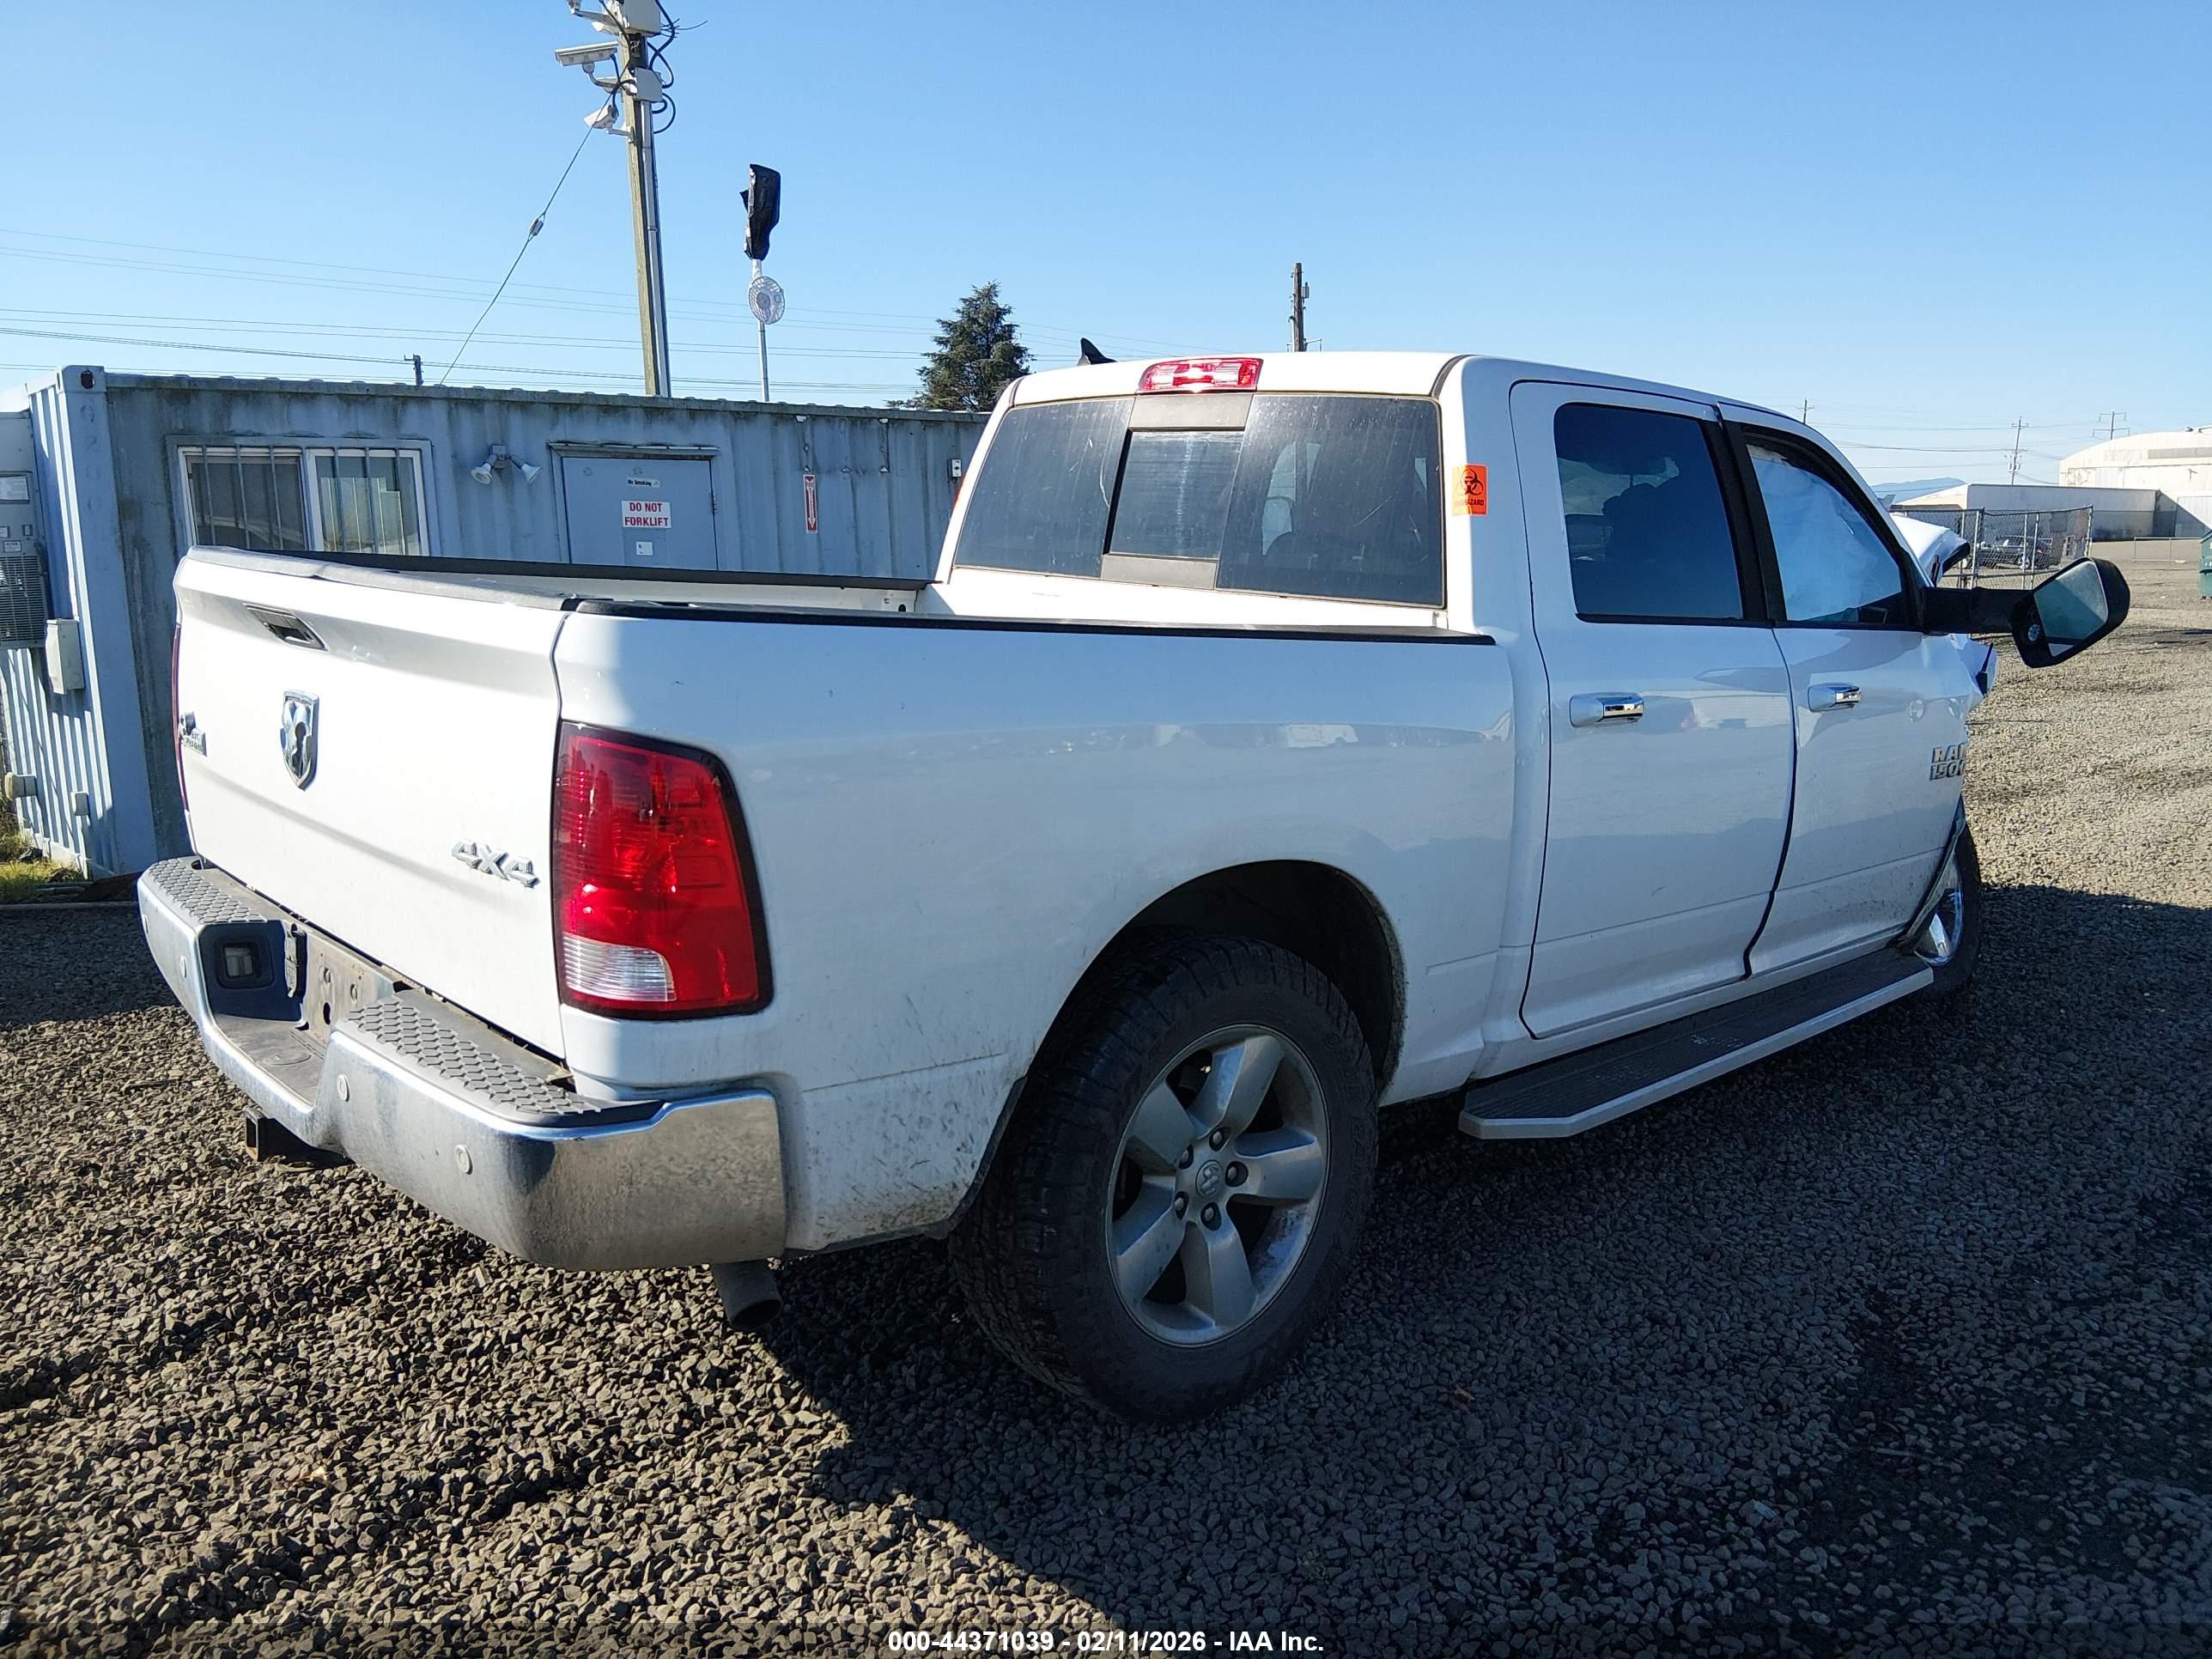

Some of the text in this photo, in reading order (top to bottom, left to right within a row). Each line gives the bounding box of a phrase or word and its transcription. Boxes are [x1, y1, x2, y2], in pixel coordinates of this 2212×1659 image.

[629, 502, 662, 513] DO NOT
[625, 517, 668, 526] FORKLIFT
